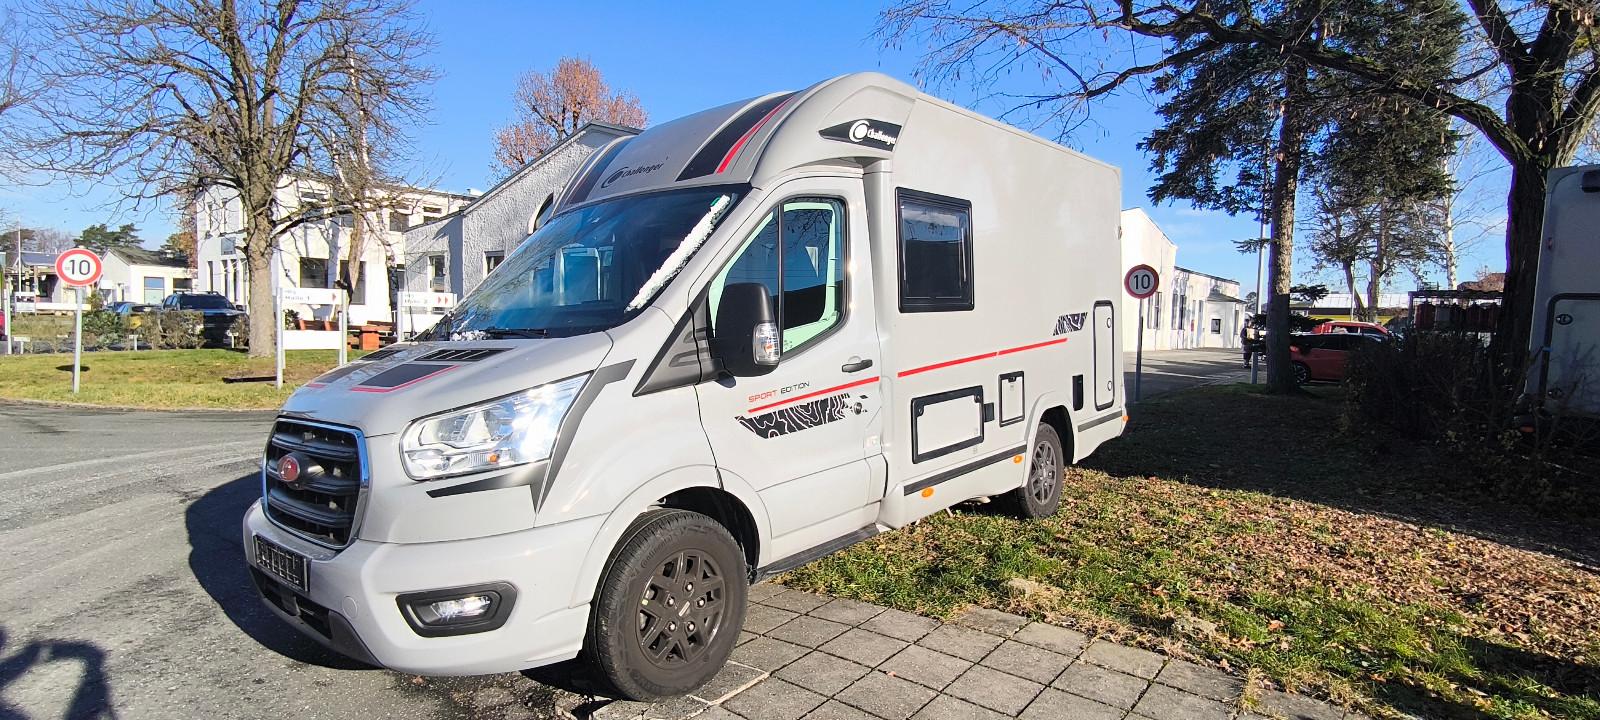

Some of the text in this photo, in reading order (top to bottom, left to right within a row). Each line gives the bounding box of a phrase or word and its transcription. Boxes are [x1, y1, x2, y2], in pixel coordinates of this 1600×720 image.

[867, 128, 896, 145] Challenger
[69, 259, 91, 276] 10
[1133, 273, 1150, 290] 10
[748, 381, 810, 403] SPORT EDITION
